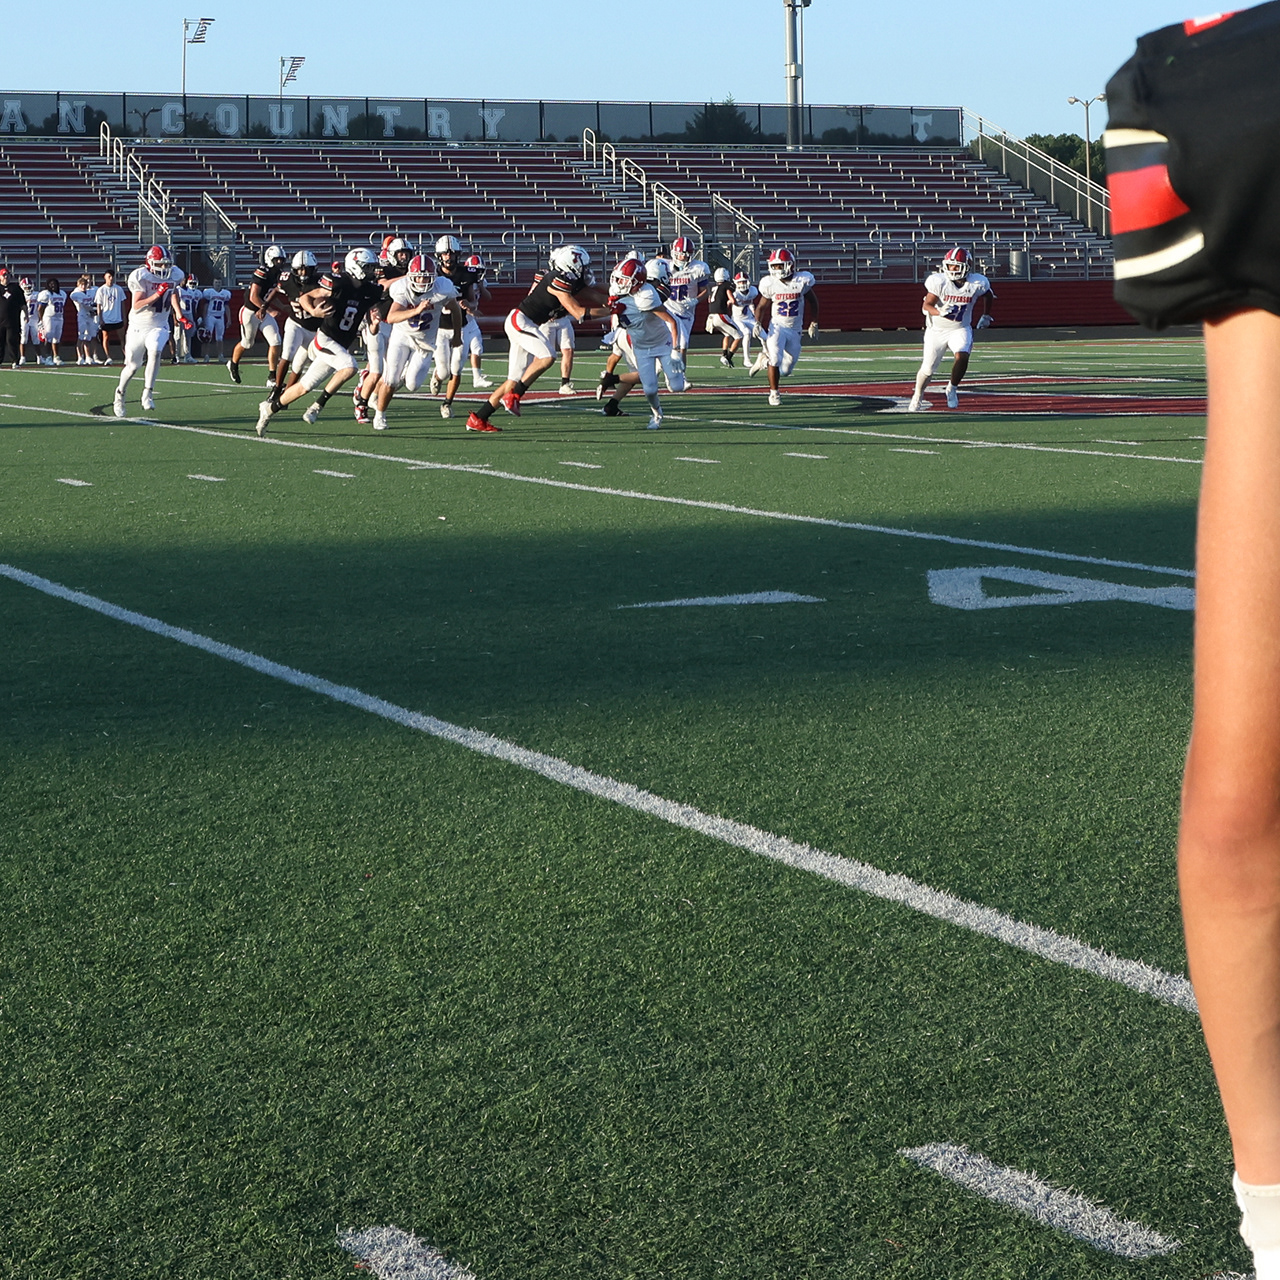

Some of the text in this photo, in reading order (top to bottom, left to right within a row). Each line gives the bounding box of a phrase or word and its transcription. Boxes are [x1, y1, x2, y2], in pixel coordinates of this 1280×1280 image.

[161, 102, 505, 139] COUNTRY
[338, 306, 358, 331] 8
[777, 301, 800, 317] 22
